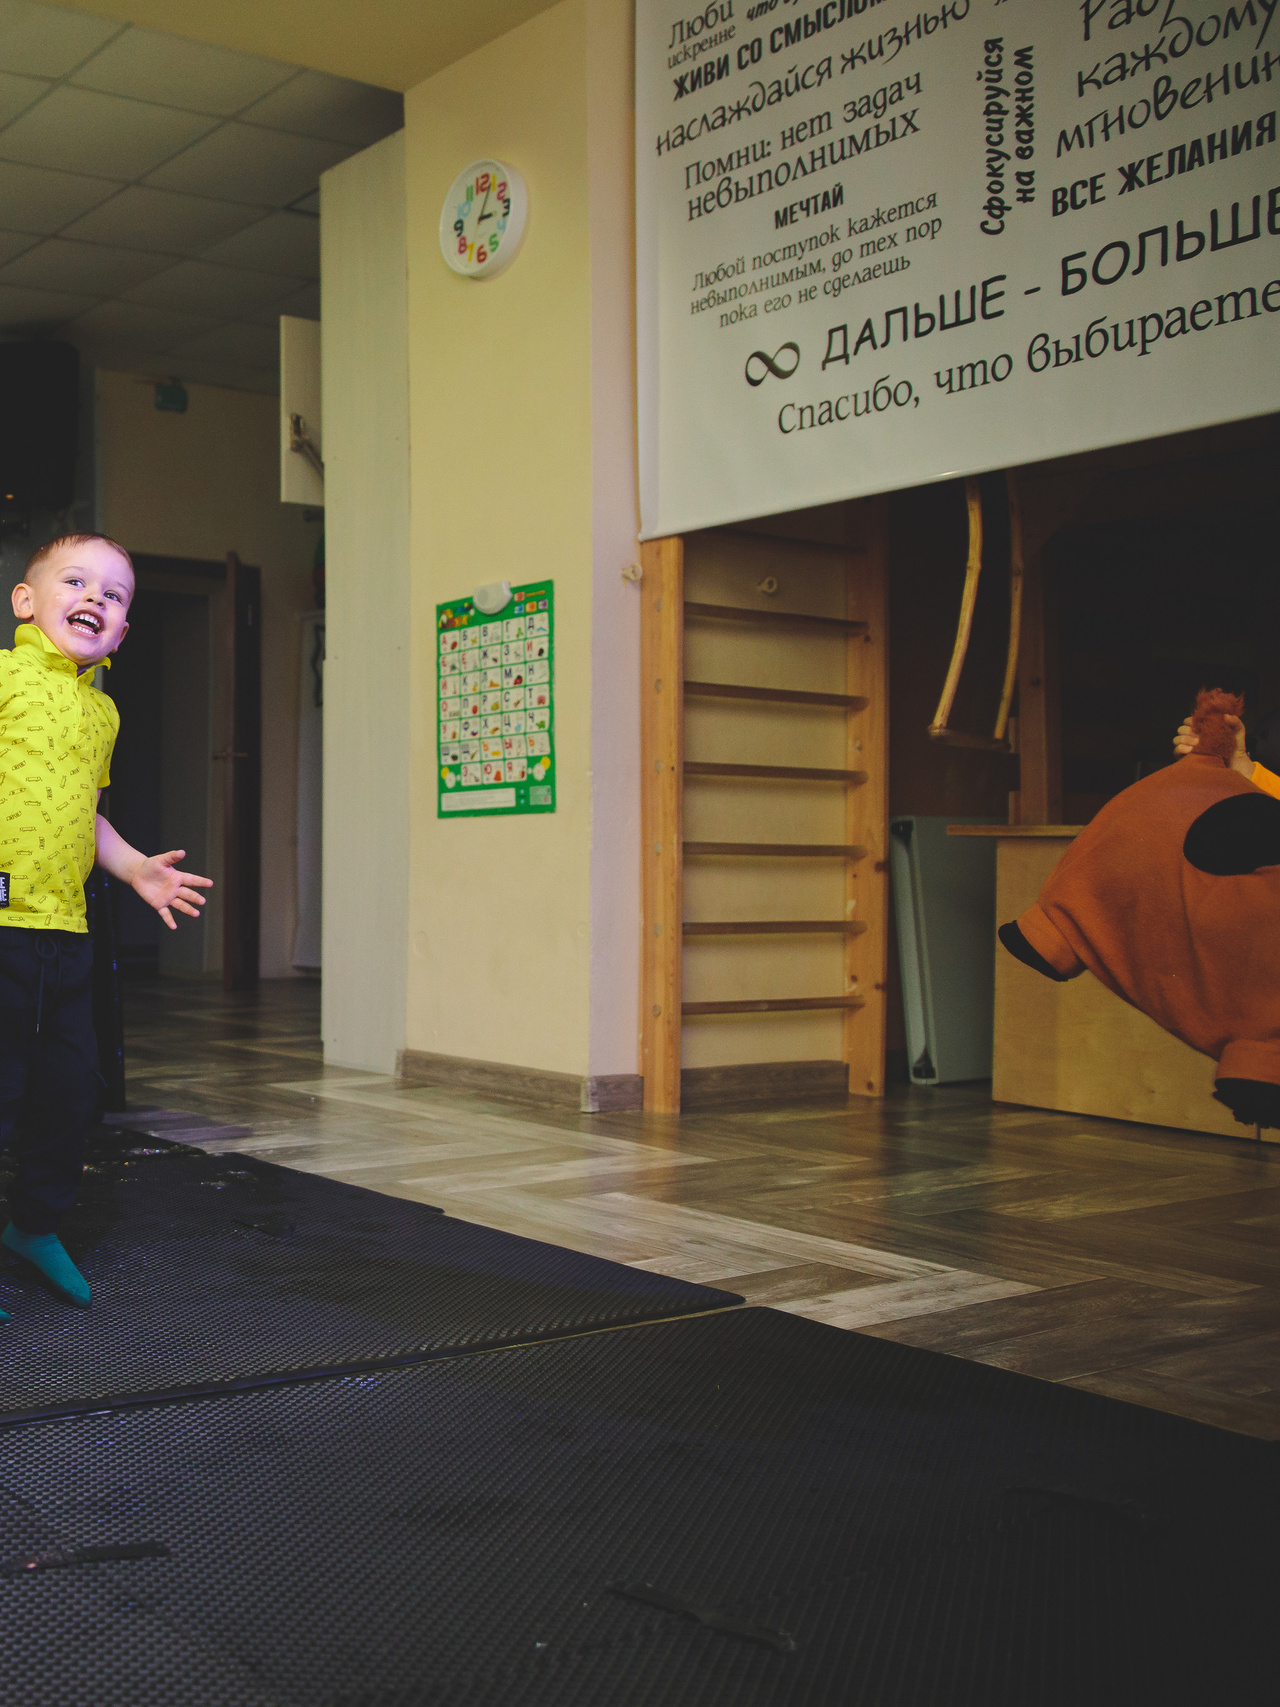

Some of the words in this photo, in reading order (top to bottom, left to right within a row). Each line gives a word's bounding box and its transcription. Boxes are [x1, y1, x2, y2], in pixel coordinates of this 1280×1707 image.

[668, 24, 736, 69] искренне
[669, 0, 734, 48] Люби
[673, 53, 730, 101] ЖИВИ
[737, 37, 762, 70] СО
[770, 0, 888, 53] СМЫСЛО
[1077, 0, 1277, 98] каждому
[656, 56, 832, 157] наслаждайся
[840, 0, 970, 75] жизнью
[1014, 45, 1035, 160] важном
[685, 139, 771, 190] Помни:
[781, 111, 833, 151] нет
[843, 72, 923, 123] задач
[976, 37, 1013, 236] Сфокусируйся
[475, 173, 490, 196] 12
[688, 108, 920, 222] невыполнимых
[1015, 170, 1036, 204] на
[1052, 172, 1106, 217] ВСЕ
[1117, 110, 1276, 196] ЖЕЛАНИЯ
[497, 181, 507, 201] 2
[502, 198, 511, 217] 3
[774, 182, 844, 230] МЕЧТАЙ
[454, 219, 464, 237] 9
[458, 236, 467, 254] 8
[466, 242, 475, 262] 7
[489, 233, 499, 252] 5
[692, 256, 746, 291] Любой
[752, 224, 841, 270] поступок
[847, 191, 938, 238] кажется
[476, 244, 487, 263] 6
[690, 257, 826, 315] невыполнимым,
[832, 248, 853, 272] до
[859, 232, 898, 259] тех
[905, 216, 942, 243] пор
[719, 302, 758, 328] пока
[764, 294, 792, 314] его
[798, 284, 818, 304] не
[823, 255, 911, 297] сделаешь
[822, 274, 1007, 371] ДАЛЬШЕ
[778, 375, 920, 434] Спасибо,
[934, 353, 1013, 395] что
[462, 630, 467, 640] Б
[504, 668, 512, 678] М
[528, 665, 534, 675] Н
[504, 691, 510, 702] С
[528, 689, 533, 699] Т
[483, 719, 488, 728] Х
[528, 712, 534, 722] Ч
